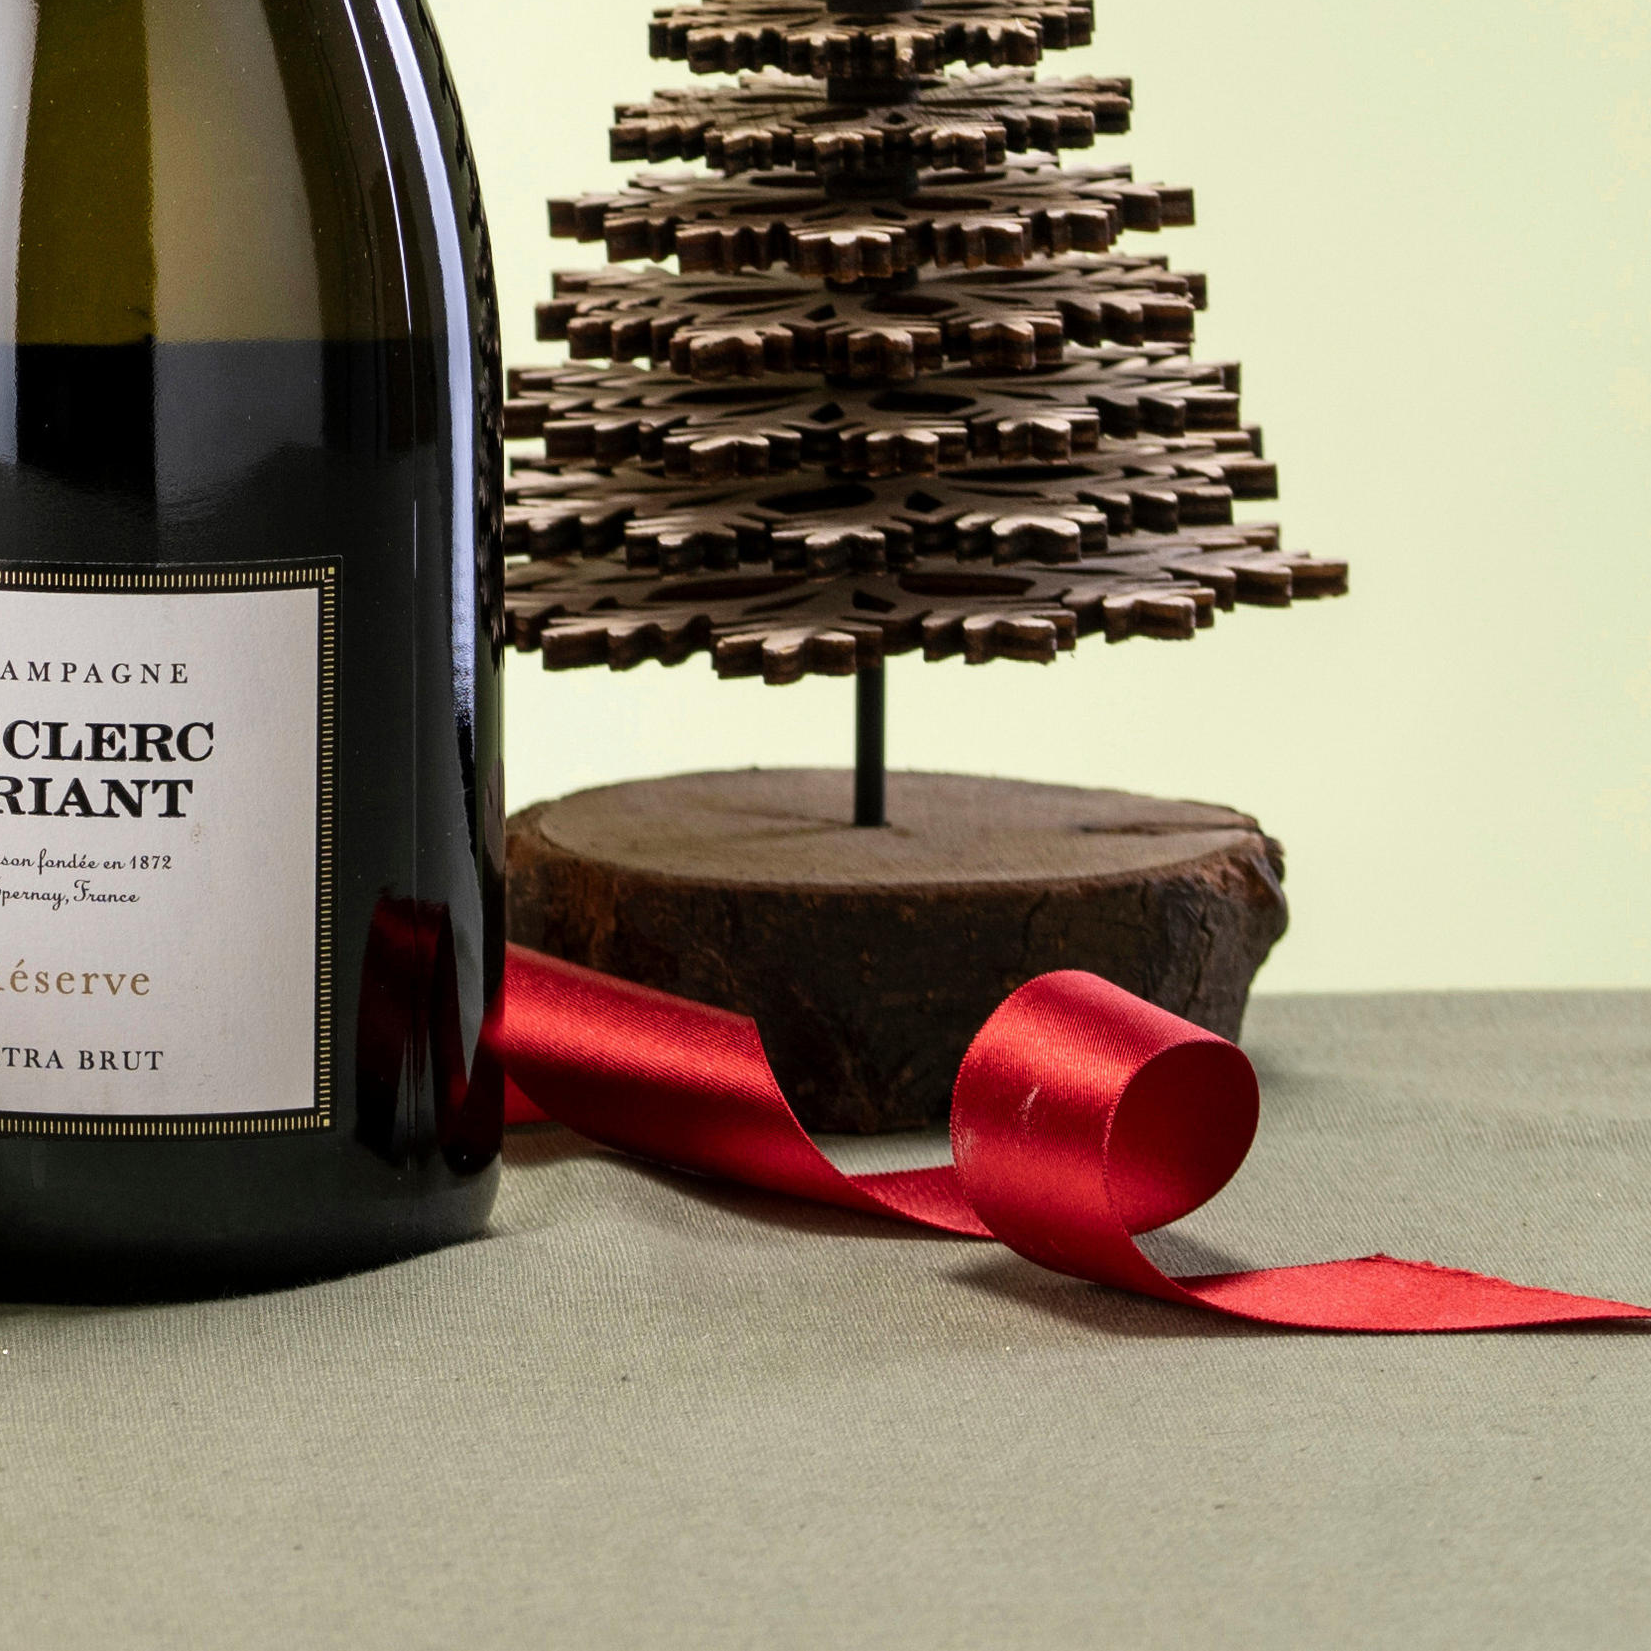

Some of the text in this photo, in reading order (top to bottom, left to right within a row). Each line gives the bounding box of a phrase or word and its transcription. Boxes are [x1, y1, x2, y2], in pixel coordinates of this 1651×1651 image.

[37, 848, 98, 875] fondée
[103, 860, 124, 870] en
[130, 855, 172, 870] 1872
[73, 879, 140, 903] France
[79, 1050, 164, 1071] BRUT
